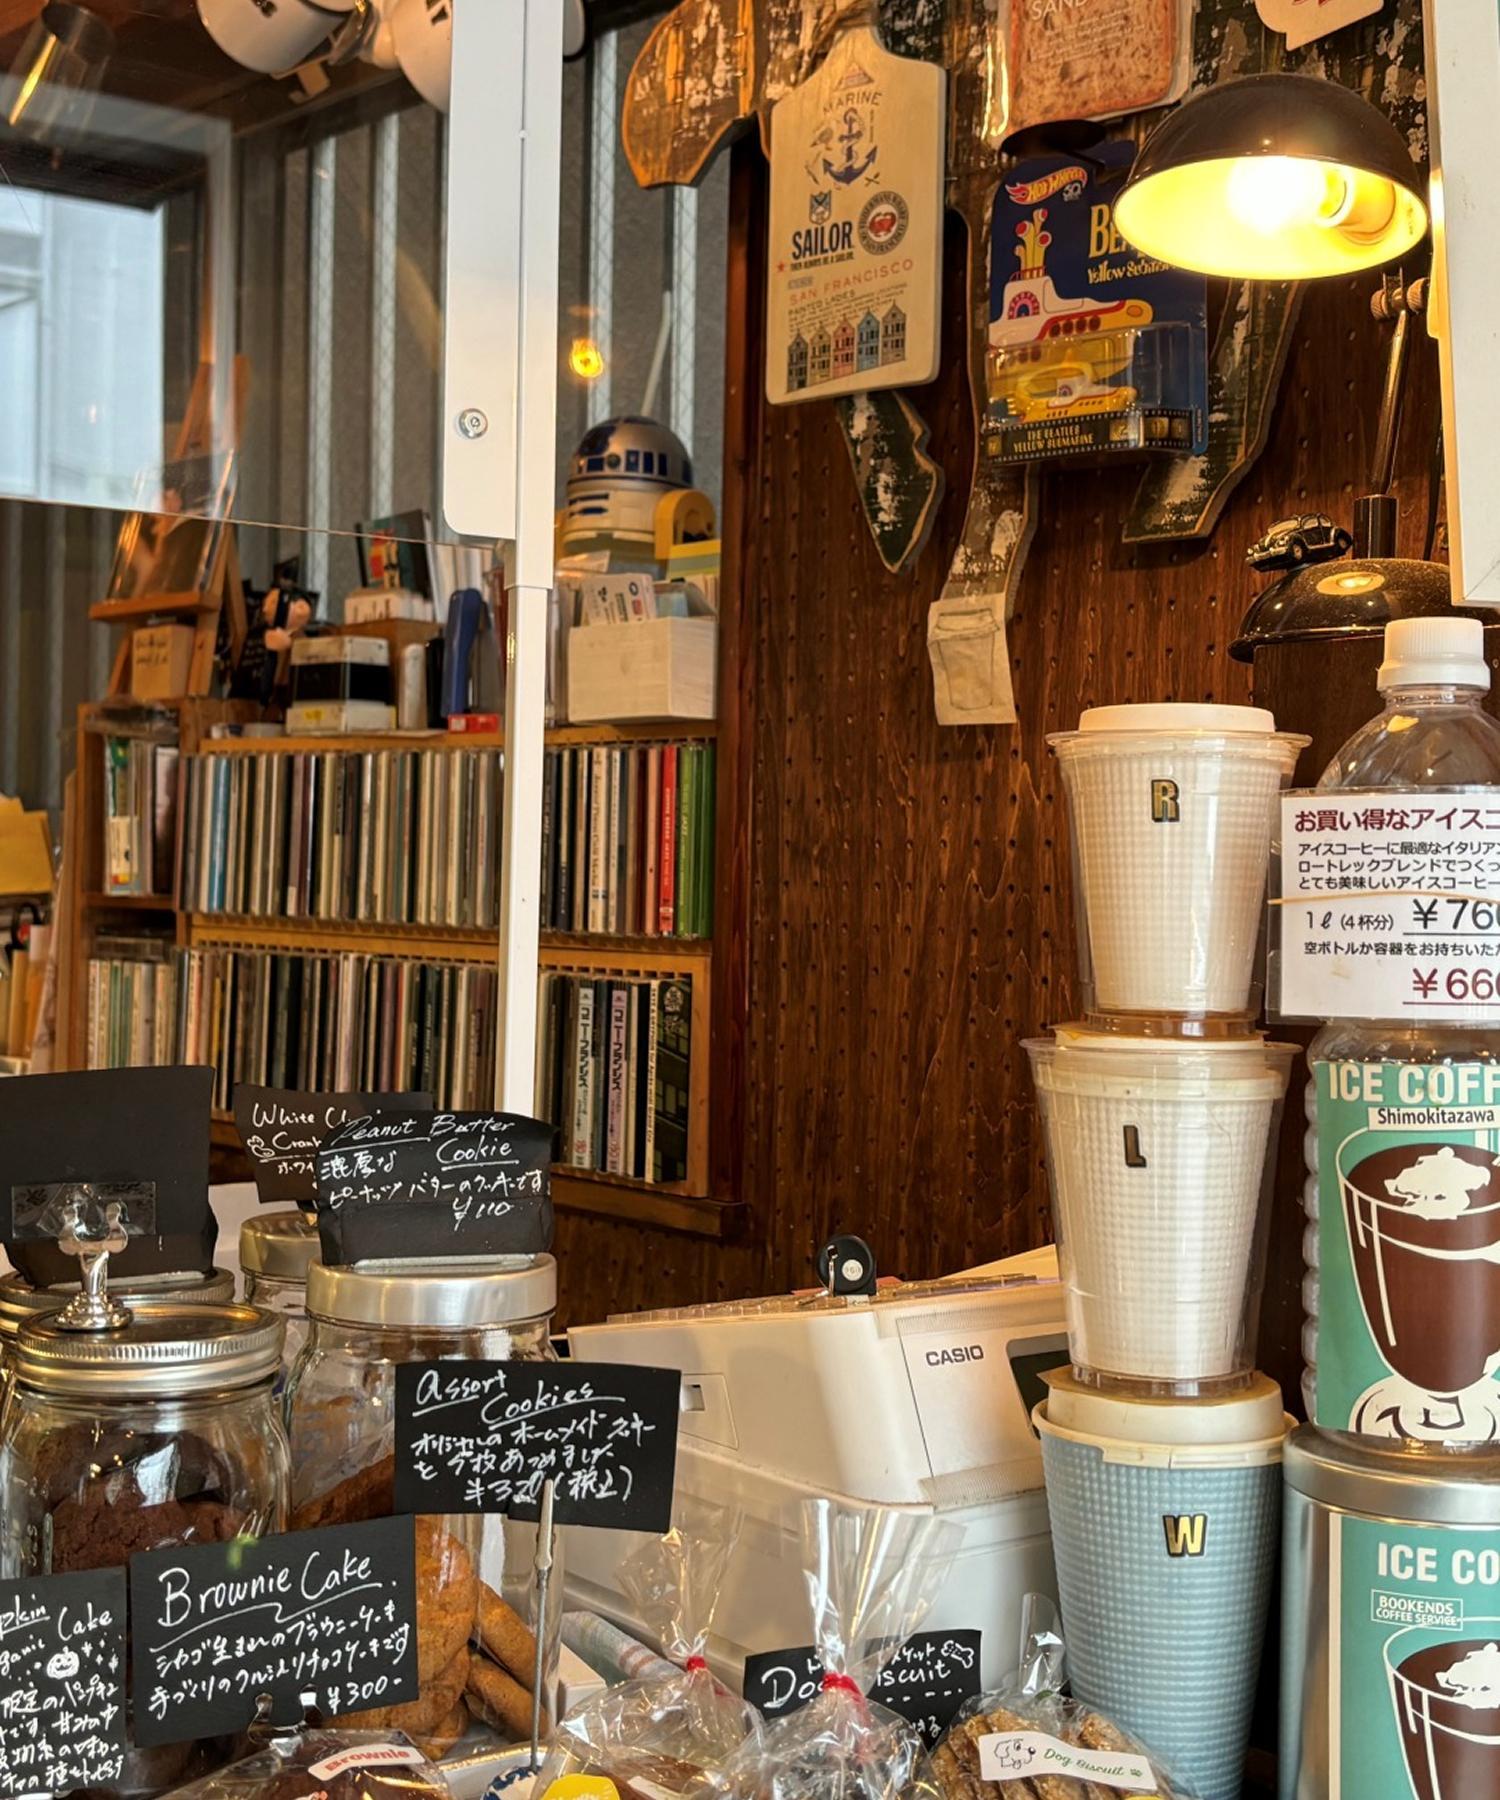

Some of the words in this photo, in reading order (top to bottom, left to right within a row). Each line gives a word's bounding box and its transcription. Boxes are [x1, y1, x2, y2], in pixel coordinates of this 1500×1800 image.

[823, 91, 882, 114] MARINE
[792, 221, 854, 260] SAILOR
[789, 289, 817, 305] SAN
[823, 258, 914, 292] FRANCISCO
[1088, 260, 1126, 284] Yellow
[1151, 779, 1181, 823] R
[1412, 898, 1500, 930] ¥76
[1412, 967, 1500, 1000] ¥66
[1329, 1063, 1384, 1102] ICE
[1398, 1065, 1500, 1105] COFF
[252, 1102, 316, 1128] White
[330, 1114, 418, 1147] Peanut
[1377, 1107, 1495, 1124] Shimokitazawa
[436, 1135, 513, 1164] Cookie
[1123, 1125, 1148, 1168] L
[926, 1344, 985, 1367] CASIO
[481, 1380, 595, 1424] Cookies
[1162, 1513, 1208, 1558] W
[1378, 1542, 1438, 1583] ICE
[1451, 1549, 1500, 1585] CO
[157, 1564, 292, 1628] Brownie
[300, 1548, 372, 1600] Cake
[1376, 1607, 1413, 1622] COFFEE
[1414, 1613, 1458, 1627] SERVICE
[1379, 1596, 1454, 1615] BOOKENDS
[58, 1602, 113, 1642] Cake
[876, 1658, 951, 1688] iscuit
[324, 1748, 411, 1772] Brownie
[1043, 1747, 1073, 1768] Dog
[1076, 1759, 1125, 1777] Biscuit
